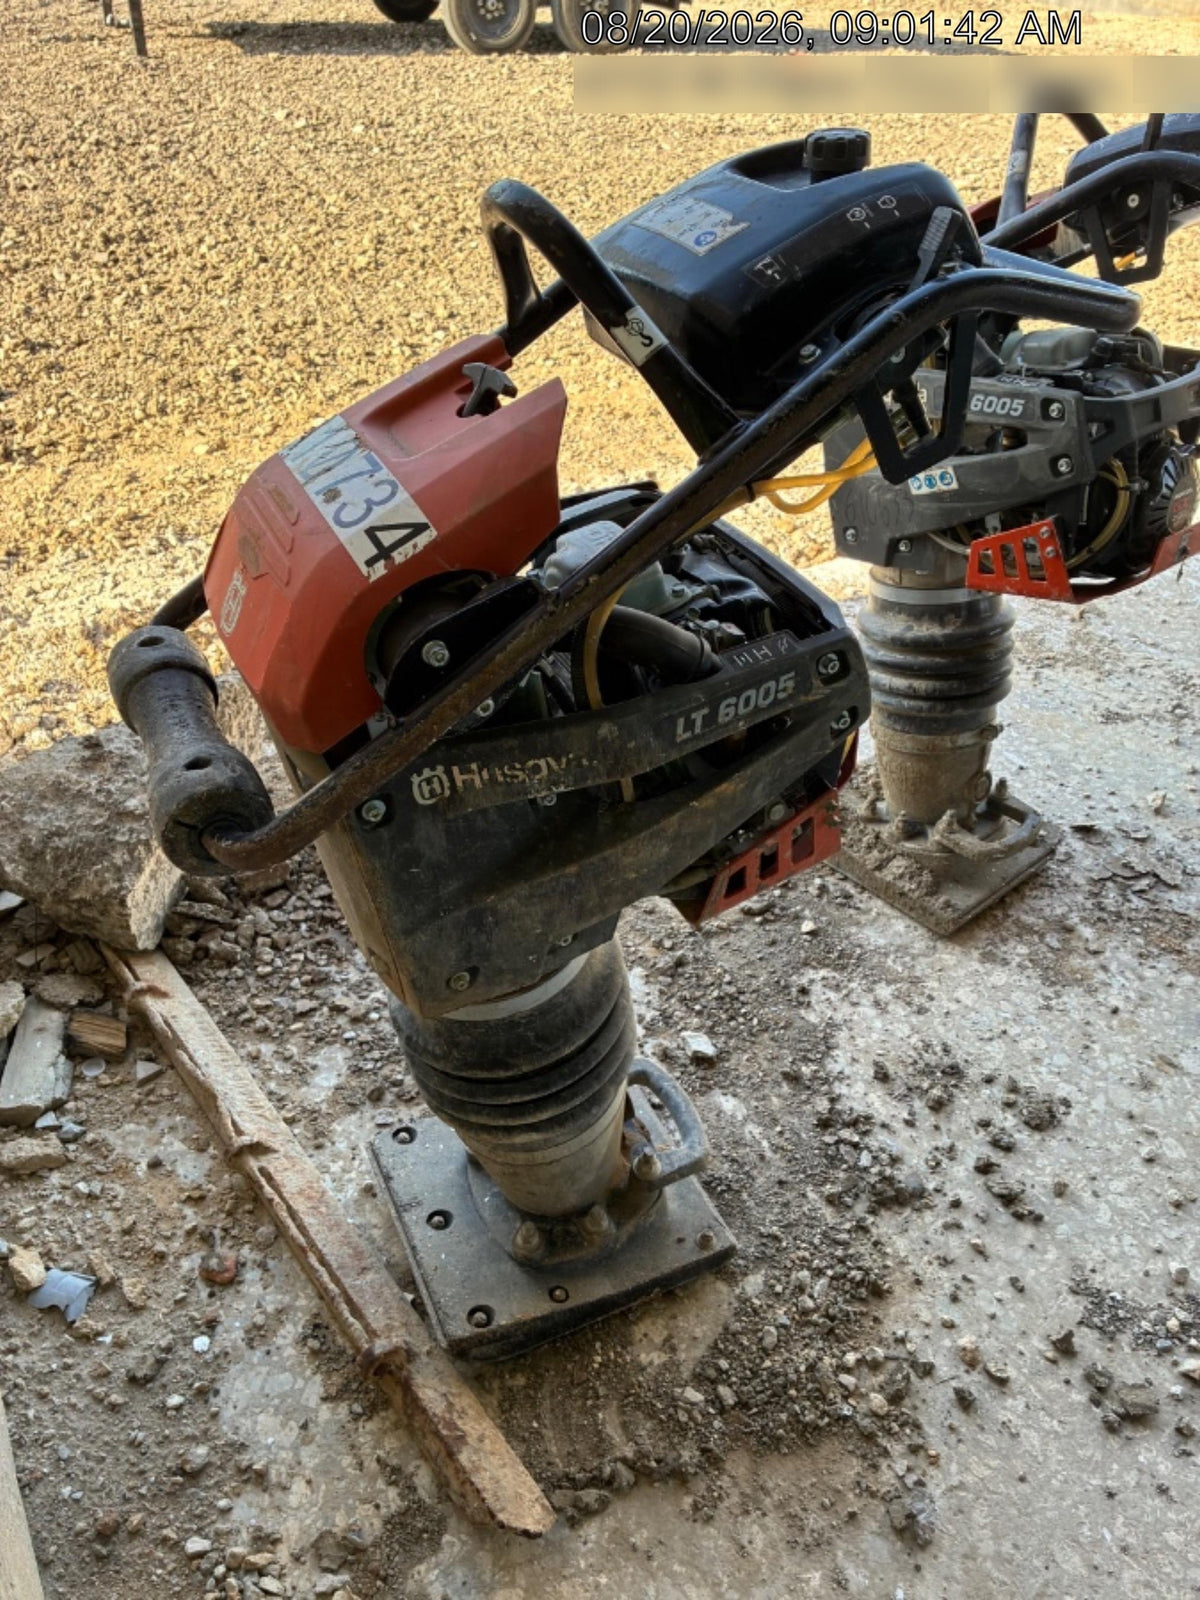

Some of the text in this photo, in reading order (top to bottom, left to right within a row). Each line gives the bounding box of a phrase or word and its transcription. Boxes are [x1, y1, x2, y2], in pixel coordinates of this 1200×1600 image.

[969, 394, 1025, 417] 6005
[676, 671, 796, 743] LT 6005
